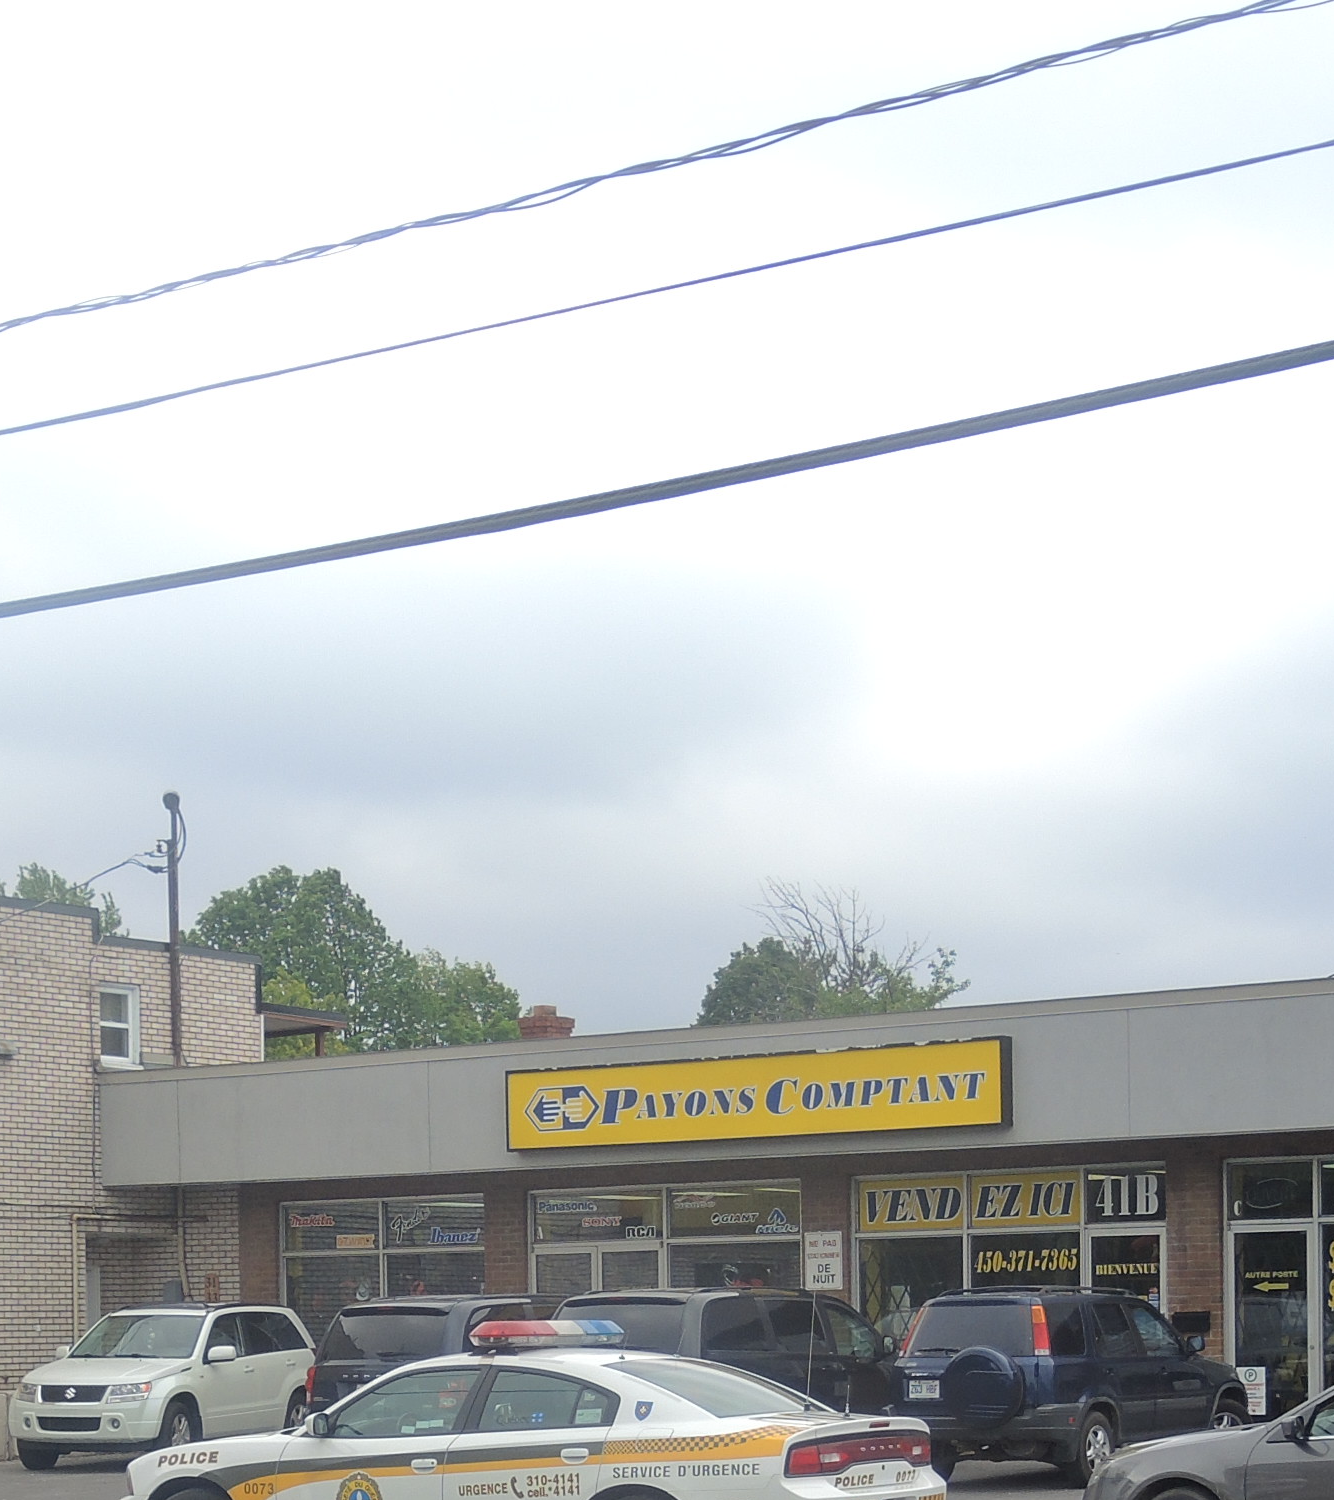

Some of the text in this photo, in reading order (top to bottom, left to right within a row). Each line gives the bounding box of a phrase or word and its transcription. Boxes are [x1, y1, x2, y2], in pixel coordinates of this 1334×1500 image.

[1028, 1180, 1076, 1217] ICI
[1095, 1173, 1159, 1217] 41B
[537, 1201, 597, 1213] Panasonic
[581, 1215, 623, 1227] SONY
[720, 1212, 759, 1224] GIANT
[427, 1227, 480, 1245] Ibanez
[974, 1248, 1078, 1274] 450-371-7365
[817, 1263, 831, 1274] DE
[1095, 1262, 1159, 1276] BIENVENUE
[1244, 1269, 1299, 1279] AUTRE PORTE
[812, 1273, 836, 1284] NUIT
[157, 1451, 219, 1468] POLICE
[612, 1463, 761, 1479] SERVICE D'URGENCE
[895, 1468, 916, 1483] 0073
[526, 1472, 581, 1487] 310-4141
[834, 1473, 875, 1488] POLICE
[244, 1482, 275, 1495] 0073
[458, 1483, 508, 1497] URGENCE
